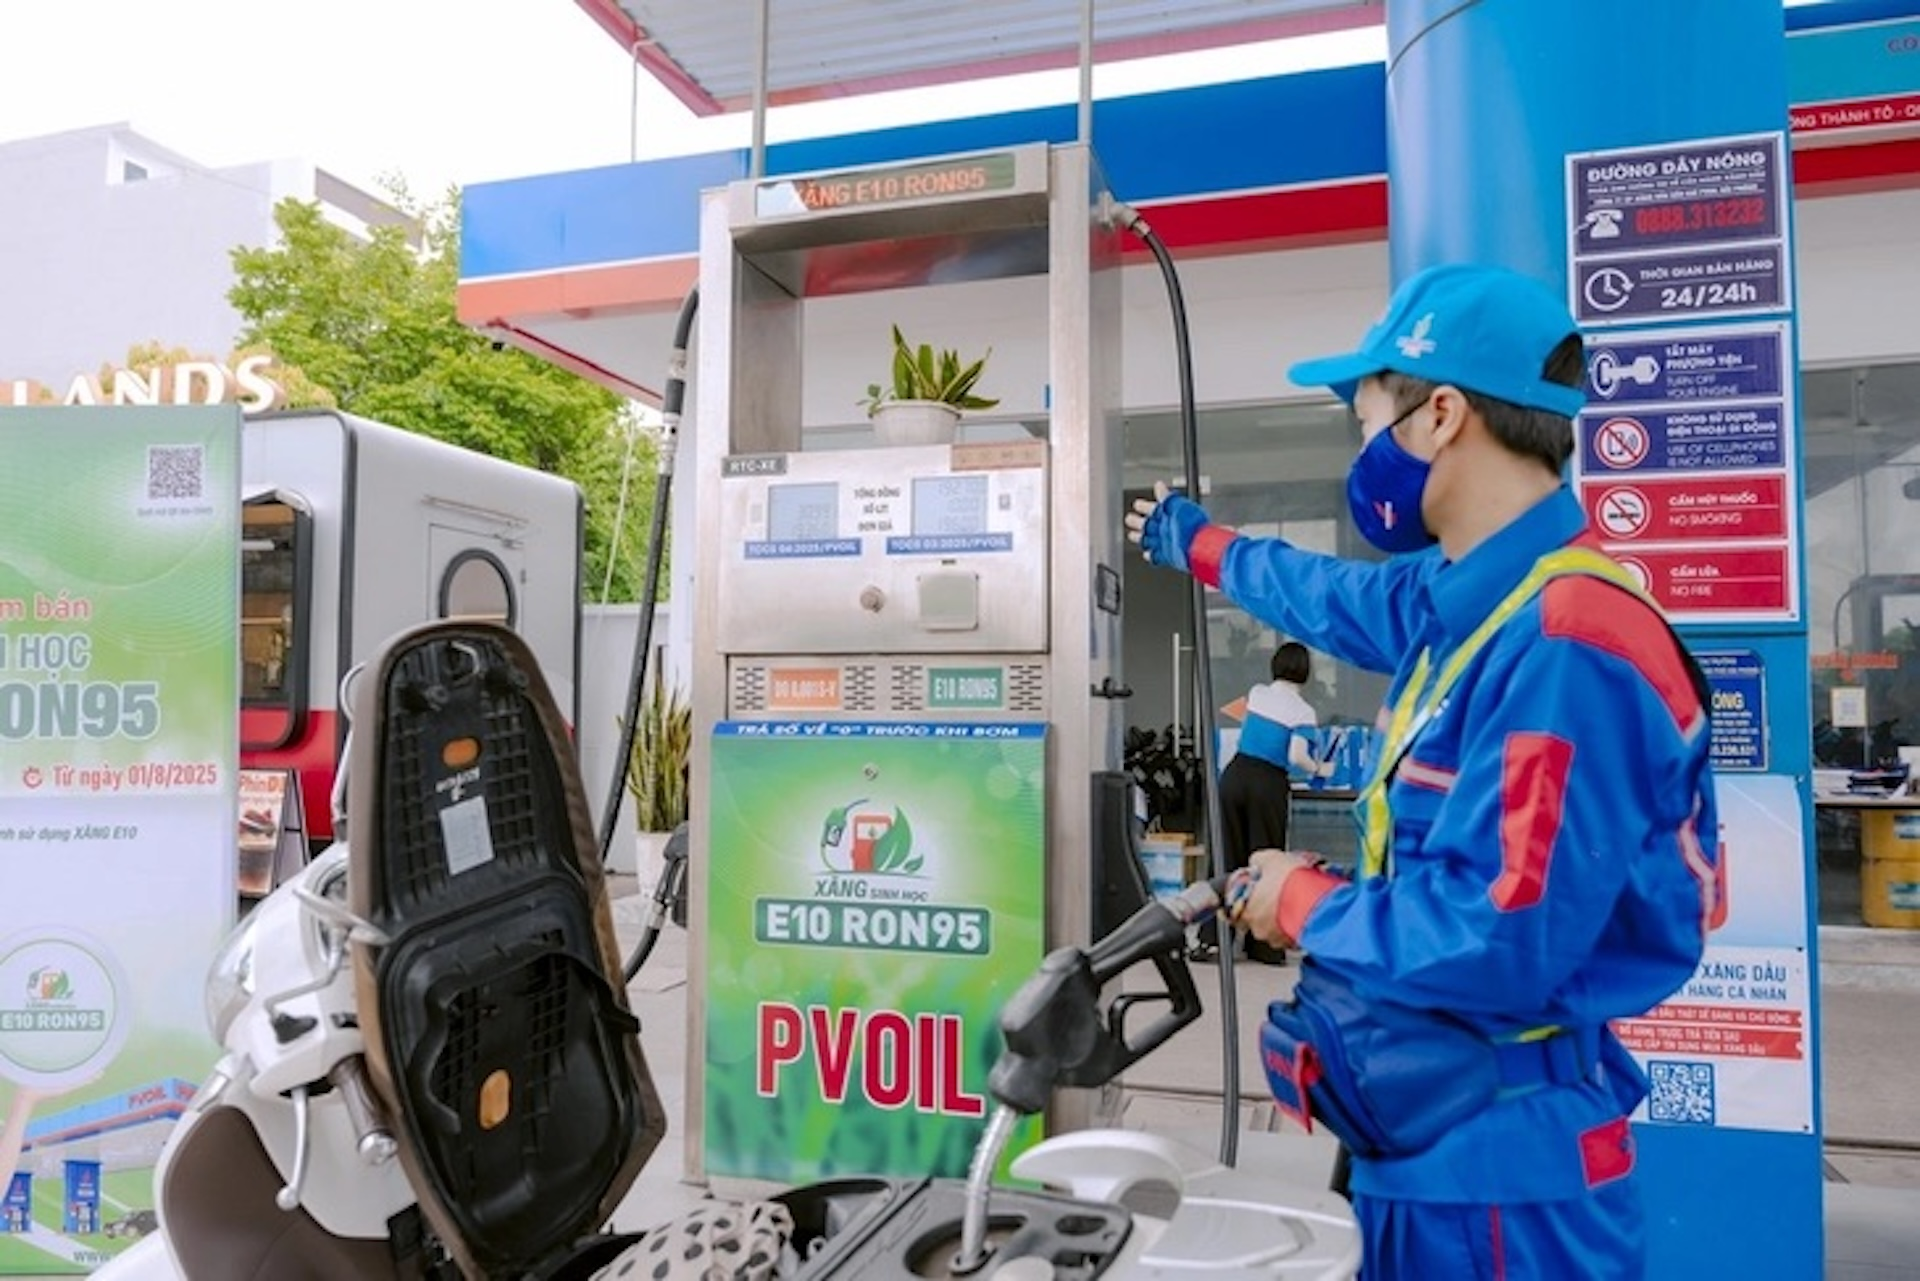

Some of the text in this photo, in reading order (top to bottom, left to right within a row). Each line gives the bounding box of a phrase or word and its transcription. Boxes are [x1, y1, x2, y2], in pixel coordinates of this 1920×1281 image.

[1872, 104, 1894, 120] TÔ
[1587, 162, 1657, 183] ĐƯỜNG
[1661, 155, 1700, 175] DÂY
[856, 178, 898, 203] E10
[904, 167, 986, 196] RON95
[1640, 258, 1774, 280] THỜI GIAN BÁN HÀNG
[1661, 282, 1756, 308] 24/24h
[1696, 374, 1716, 386] OFF
[1687, 443, 1704, 455] OF
[1677, 455, 1702, 466] NOT
[1703, 454, 1758, 466] ALLOWED
[1669, 512, 1743, 527] NO SMOKING
[1670, 585, 1689, 598] NO
[35, 590, 91, 620] bán
[20, 634, 89, 678] HỌC
[934, 678, 956, 699] E10
[1711, 688, 1745, 710] ÓNG
[737, 722, 769, 735] TRẢ
[773, 722, 799, 735] SỐ
[803, 722, 828, 735] VỀ
[866, 724, 929, 736] TRƯỚC
[935, 726, 968, 736] KHI
[972, 725, 1020, 737] BƠM
[53, 763, 218, 791] Từ ngày 01/8/2025
[38, 826, 72, 842] dụng
[74, 824, 110, 841] XĂNG
[112, 825, 139, 840] E10
[815, 876, 928, 902] XĂNG SINH HỌC
[766, 902, 984, 951] E10 RON95
[1753, 961, 1788, 982] DẦU
[2, 1012, 102, 1030] E10 RON95
[757, 1001, 985, 1118] PVOIL
